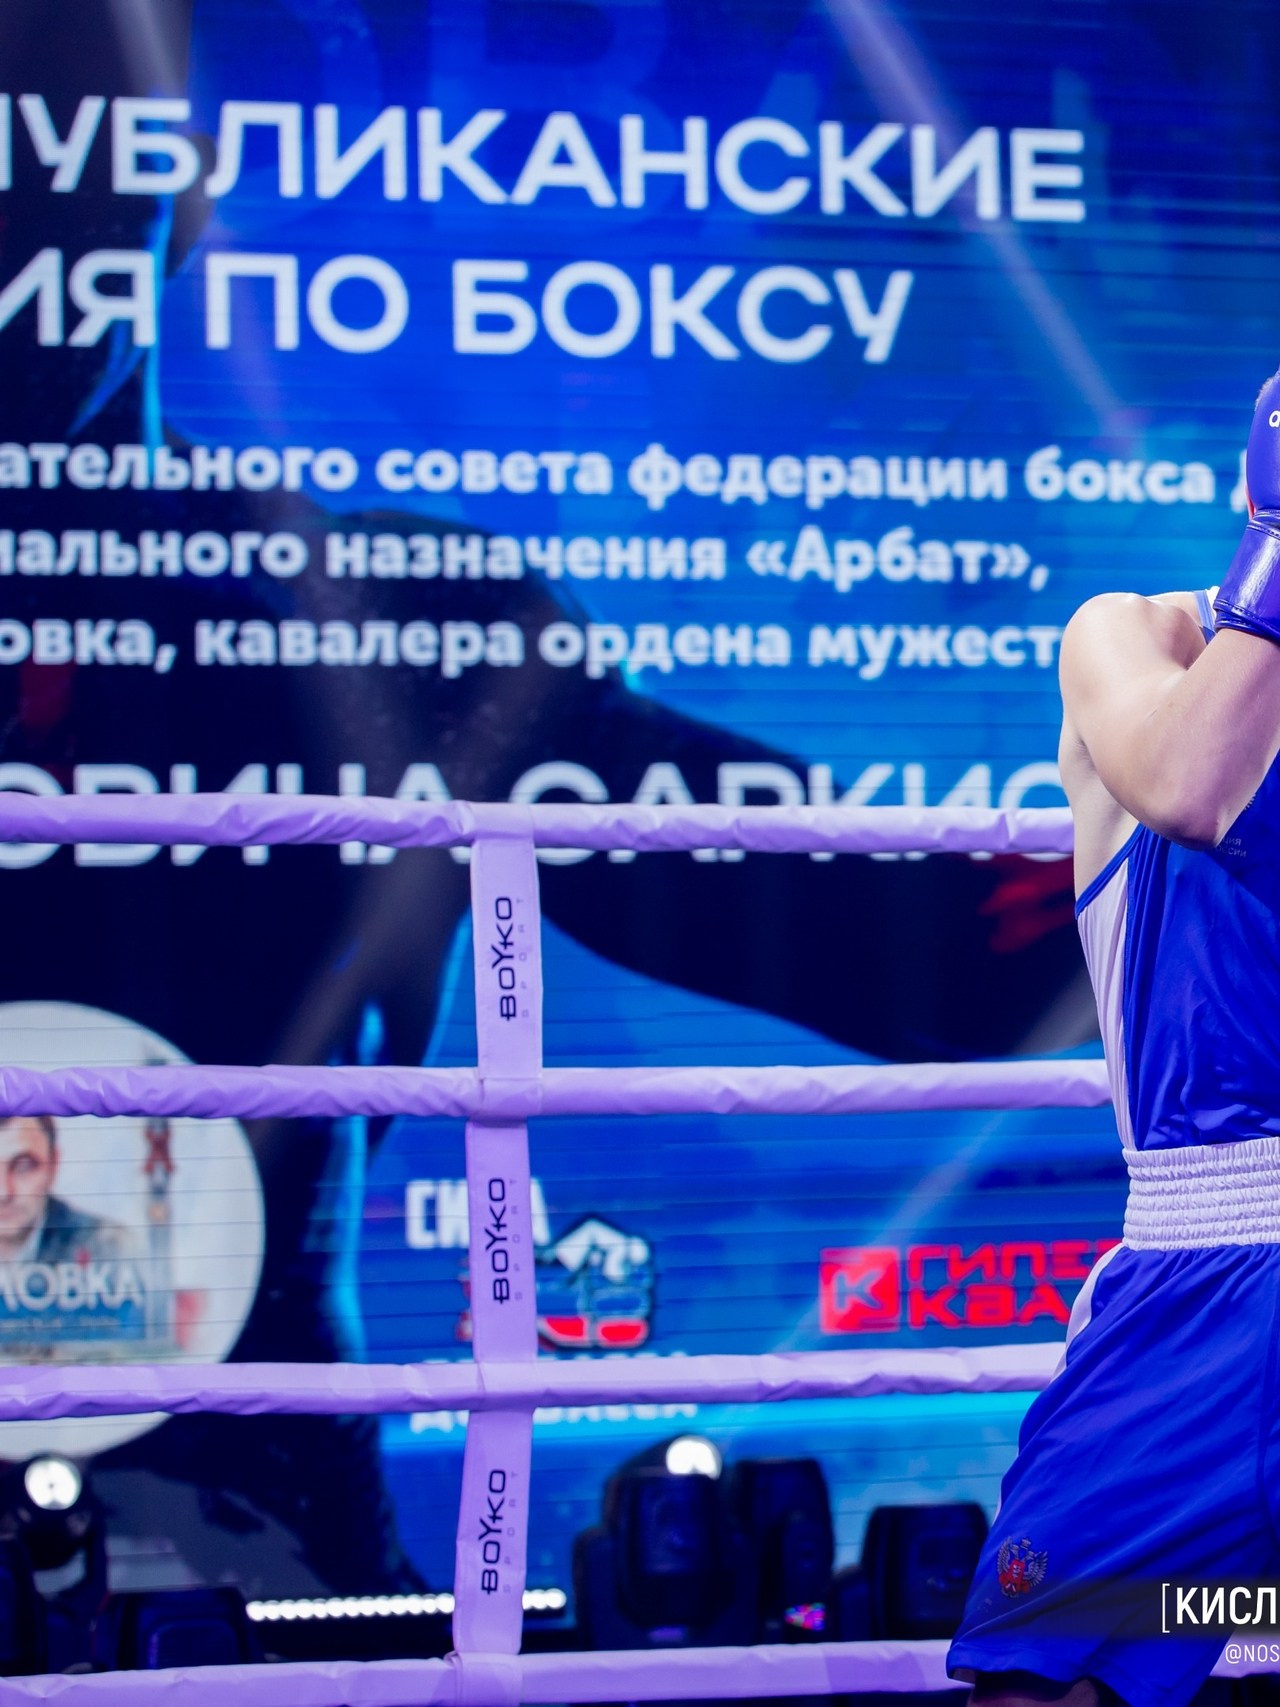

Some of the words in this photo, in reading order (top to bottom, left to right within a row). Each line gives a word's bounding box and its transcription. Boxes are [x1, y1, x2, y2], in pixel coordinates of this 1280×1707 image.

[0, 94, 1086, 222] УБЛИКАНСКИЕ
[205, 252, 409, 353] ПО
[453, 259, 913, 363] БОКСУ
[376, 449, 612, 495] совета
[628, 443, 1008, 509] федерации
[1024, 446, 1215, 503] бокса
[325, 533, 726, 580] назначения
[746, 526, 1049, 593] «Арбат»,
[195, 621, 523, 678] кавалера
[538, 623, 791, 678] ордена
[491, 897, 517, 1021] BOYKO
[484, 1178, 510, 1304] BOYKO
[478, 1469, 506, 1595] BOYKO
